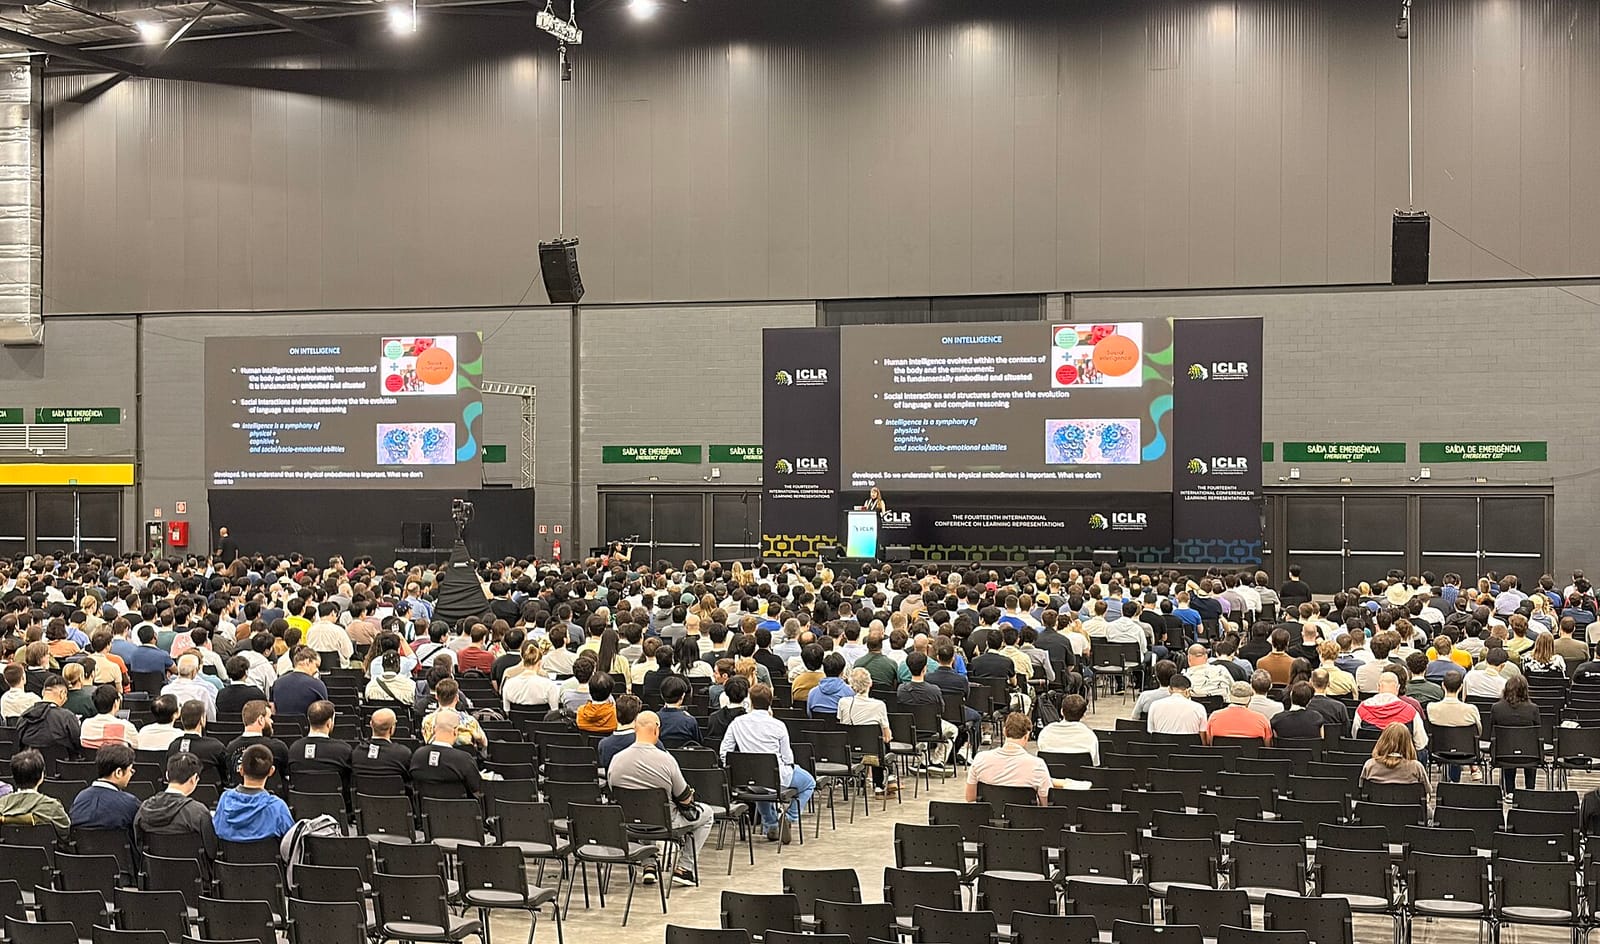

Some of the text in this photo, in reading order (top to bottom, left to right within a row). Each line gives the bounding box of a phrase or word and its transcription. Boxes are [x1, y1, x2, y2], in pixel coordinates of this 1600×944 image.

[1212, 362, 1248, 373] ICLR
[796, 369, 828, 379] ICLR
[907, 375, 953, 383] fundamentally
[902, 401, 932, 409] language
[948, 400, 975, 409] complex
[977, 400, 1010, 408] reasoning
[313, 422, 320, 430] of
[969, 418, 978, 426] of
[622, 447, 638, 455] SAÍDA
[649, 447, 682, 455] EMERGÊNCIA
[730, 447, 746, 455] SAÍDA
[1307, 445, 1327, 453] SAÍDA
[1340, 445, 1380, 453] EMERGÊNCIA
[1445, 444, 1465, 453] SAÍDA
[1479, 444, 1521, 453] EMERGÊNCIA
[796, 458, 828, 468] ICLR
[1212, 457, 1248, 468] ICLR
[882, 512, 911, 522] CLR
[1112, 513, 1147, 523] ICLR
